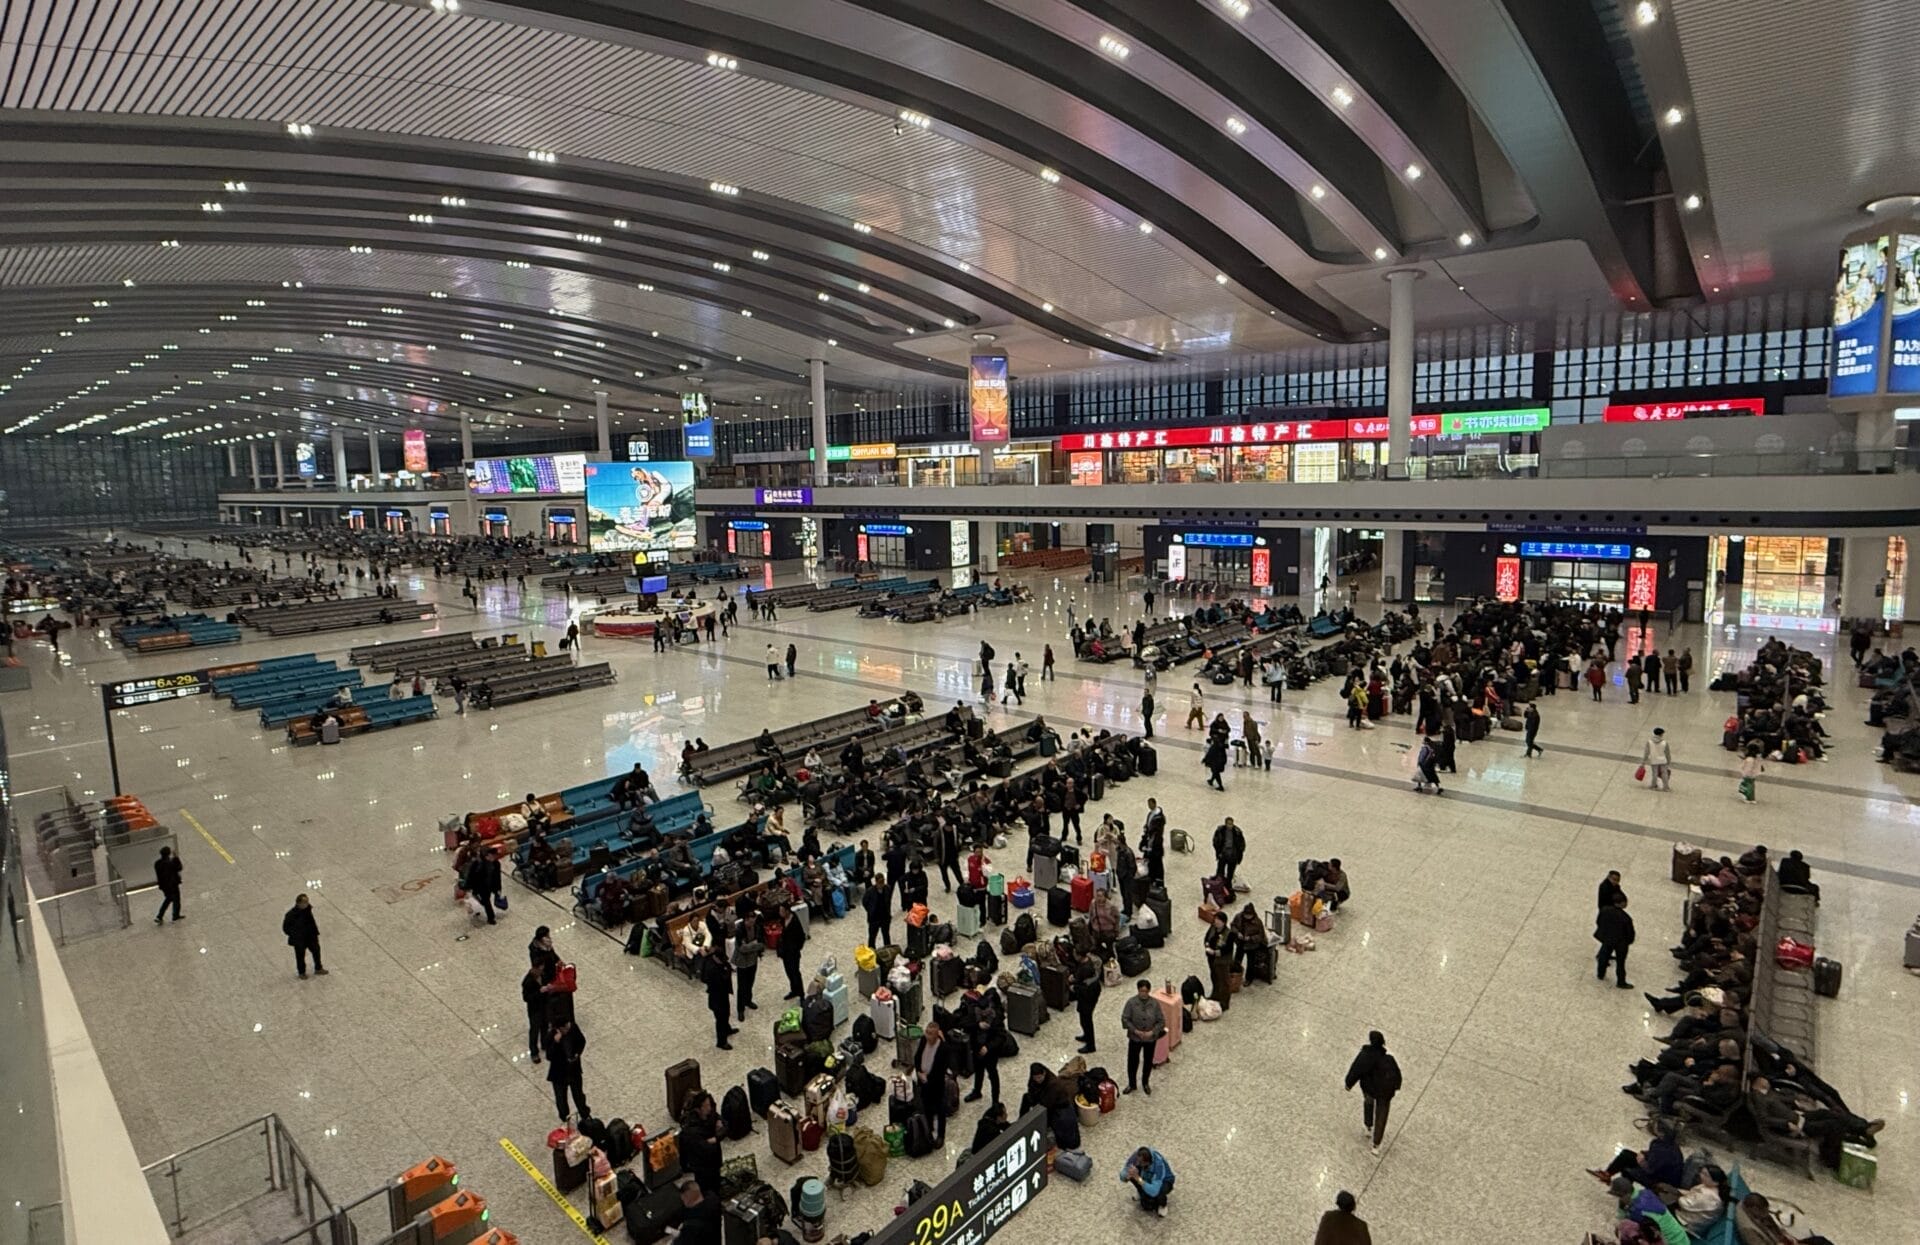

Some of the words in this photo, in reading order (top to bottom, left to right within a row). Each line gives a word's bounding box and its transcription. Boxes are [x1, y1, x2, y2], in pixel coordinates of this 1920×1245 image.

[1209, 423, 1313, 443] 川渝特产汇
[973, 1155, 1006, 1194] 检票口
[910, 1199, 964, 1245] 29A
